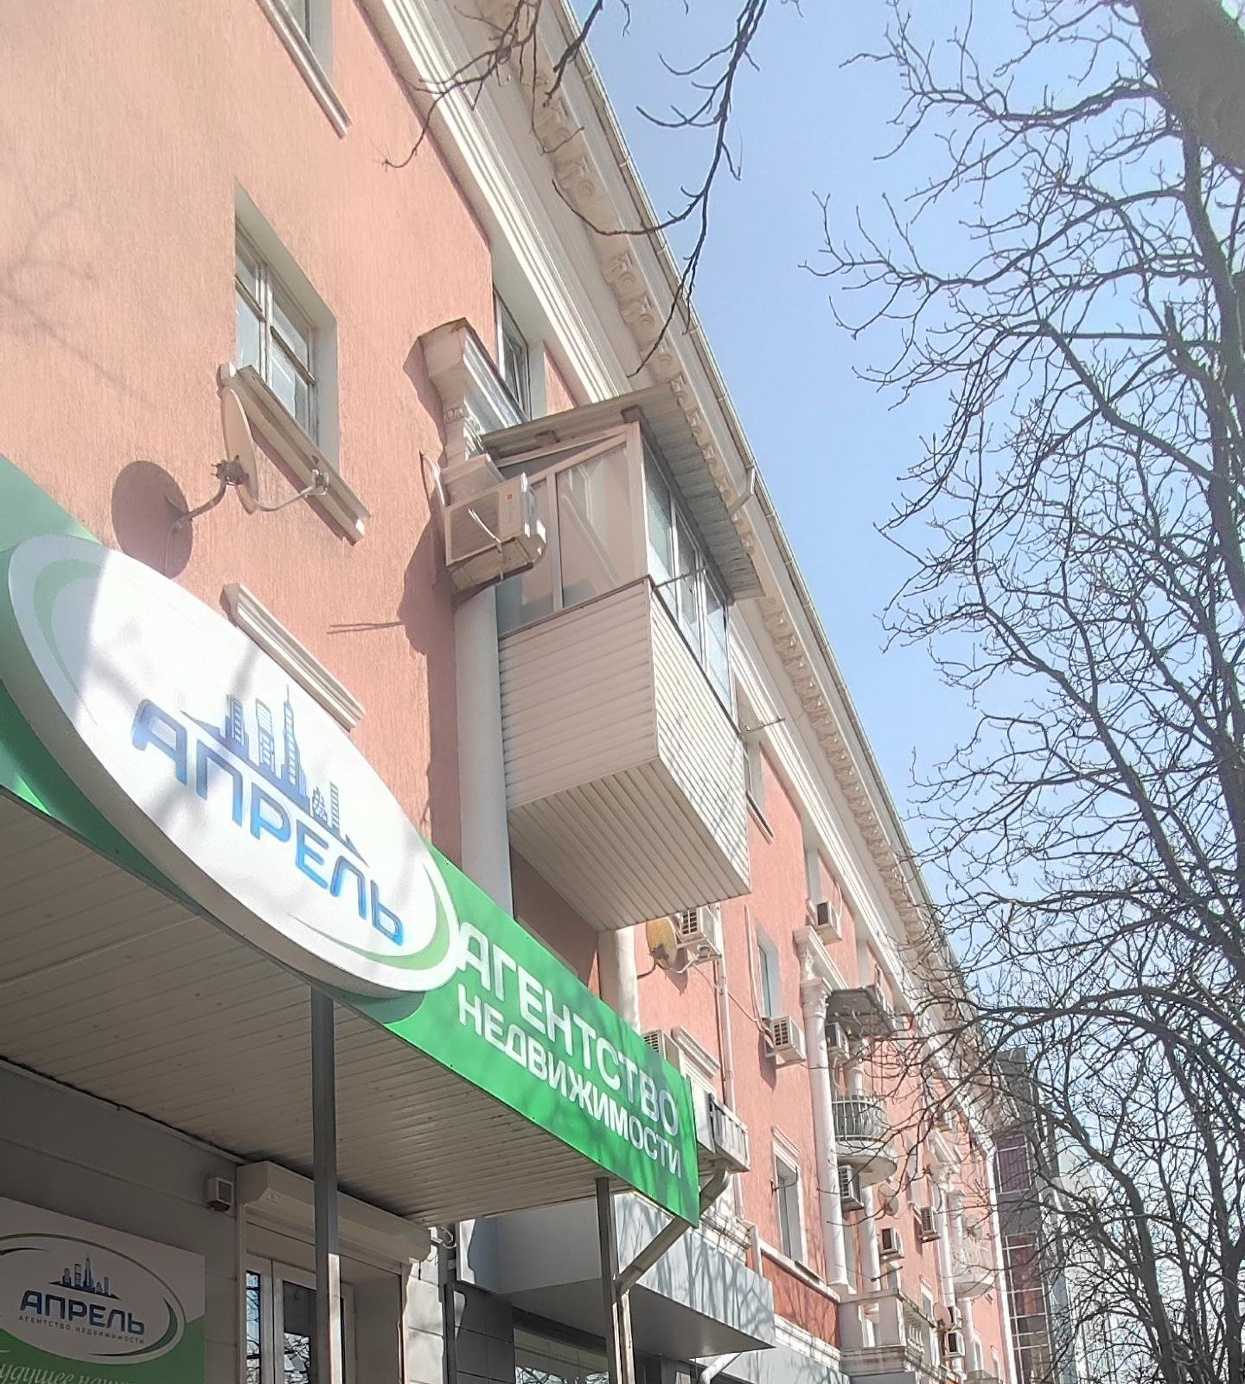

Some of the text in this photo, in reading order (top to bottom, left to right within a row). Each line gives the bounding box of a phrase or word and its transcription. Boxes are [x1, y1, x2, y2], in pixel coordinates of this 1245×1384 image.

[131, 698, 403, 946] АПРЕЛЬ
[456, 922, 679, 1137] АГЕНТСТВО
[458, 984, 682, 1178] НЕДВИЖИМОСТИ
[20, 1289, 145, 1336] АПРЕЛЬ
